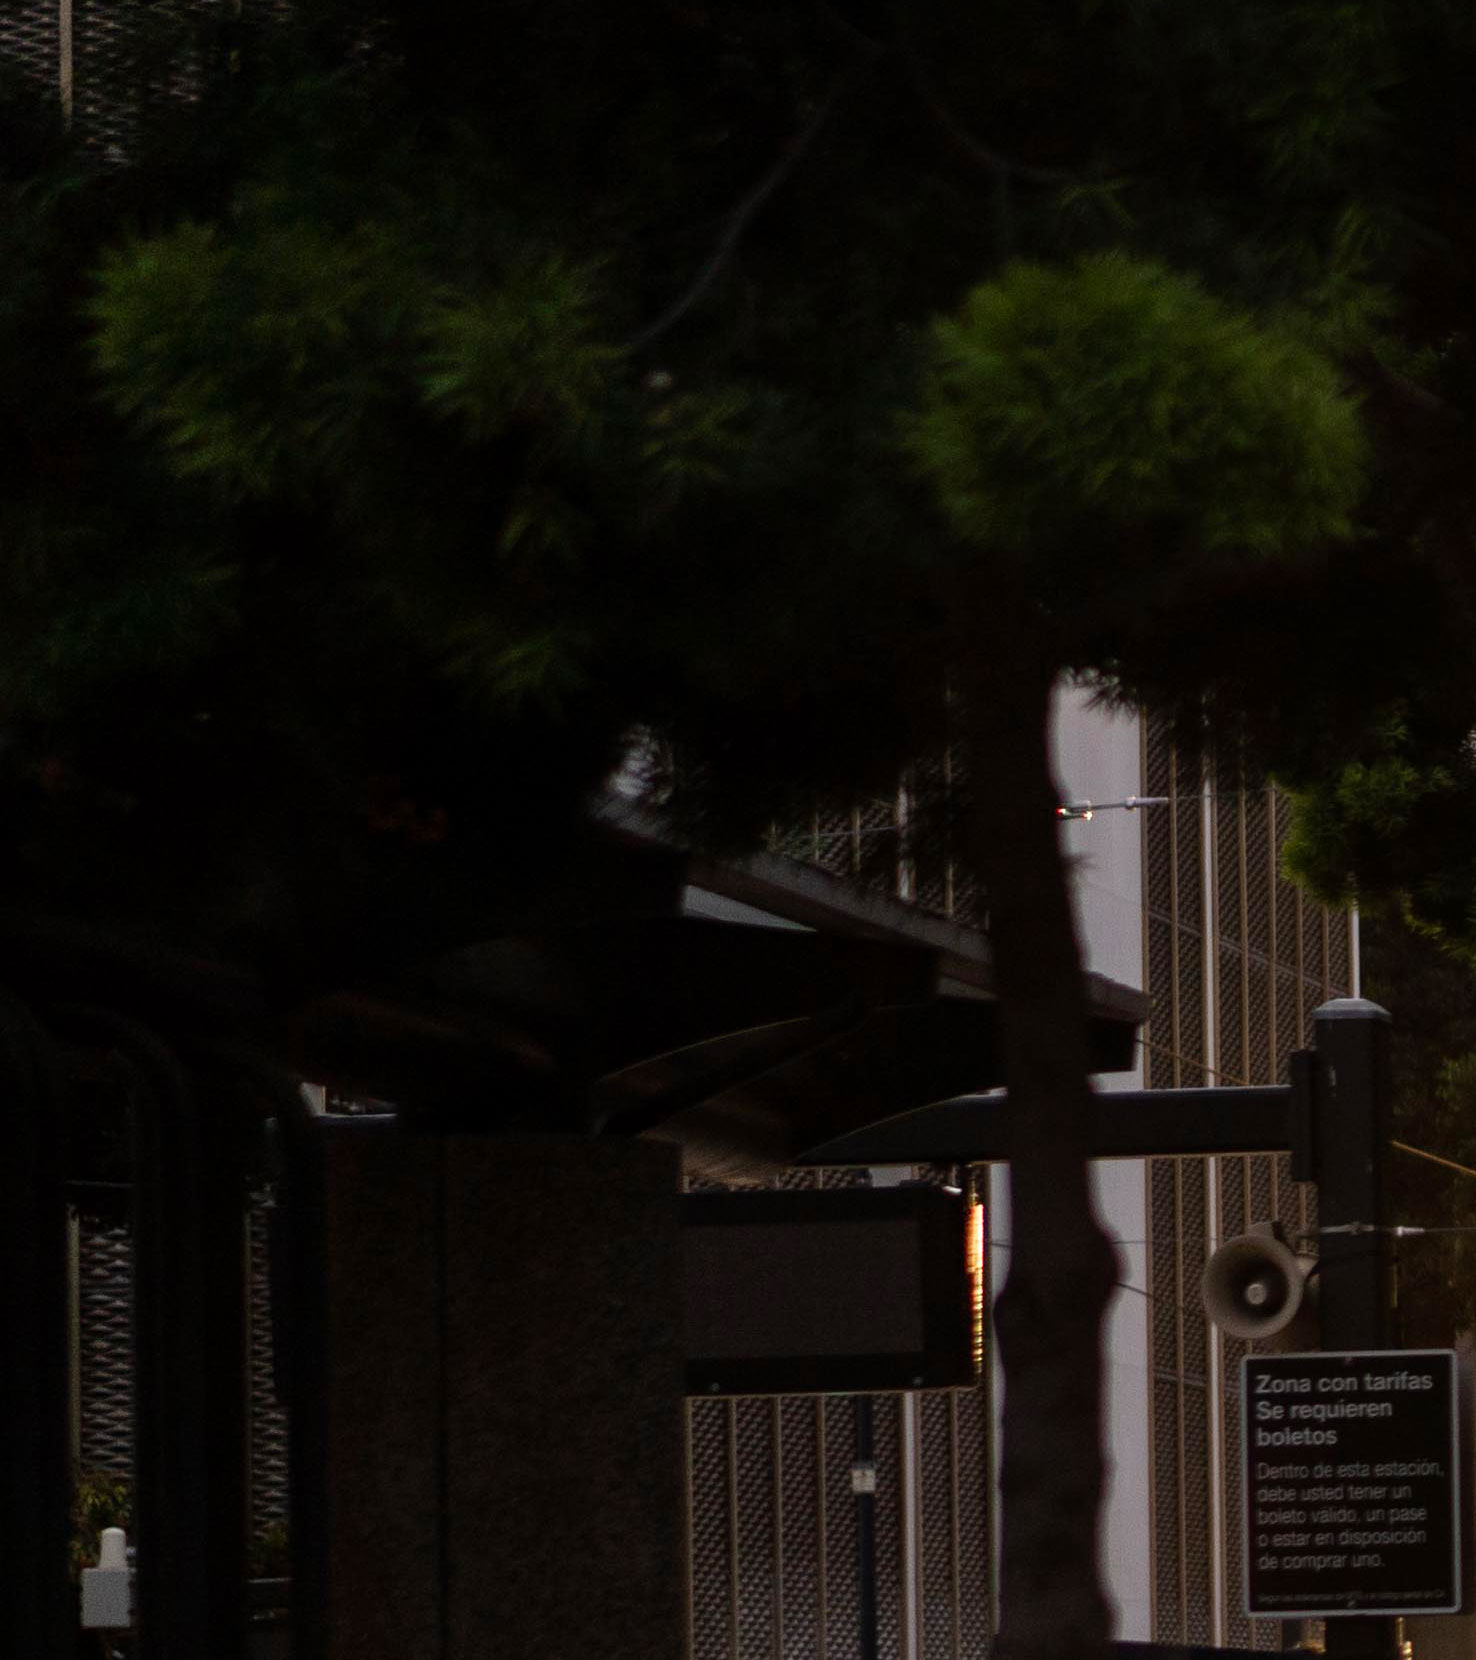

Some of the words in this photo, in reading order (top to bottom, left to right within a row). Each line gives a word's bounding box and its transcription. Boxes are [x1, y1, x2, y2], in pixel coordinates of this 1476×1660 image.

[1256, 1374, 1311, 1394] Zona
[1318, 1376, 1357, 1392] con
[1364, 1371, 1433, 1391] tarifas
[1256, 1402, 1284, 1421] Se
[1290, 1399, 1392, 1422] requieren
[1257, 1428, 1338, 1446] boletos
[1256, 1462, 1310, 1480] Dentro
[1312, 1463, 1332, 1478] de
[1337, 1462, 1370, 1478] esta
[1256, 1485, 1297, 1502] debe
[1301, 1484, 1344, 1501] usted
[1349, 1484, 1388, 1500] tener
[1391, 1485, 1412, 1499] un
[1257, 1508, 1306, 1525] boleto
[1365, 1509, 1385, 1522] un
[1389, 1506, 1428, 1524] pase
[1257, 1534, 1268, 1547] o
[1272, 1531, 1310, 1547] estar
[1315, 1532, 1335, 1546] en
[1258, 1554, 1279, 1569] de
[1282, 1555, 1348, 1572] comprar
